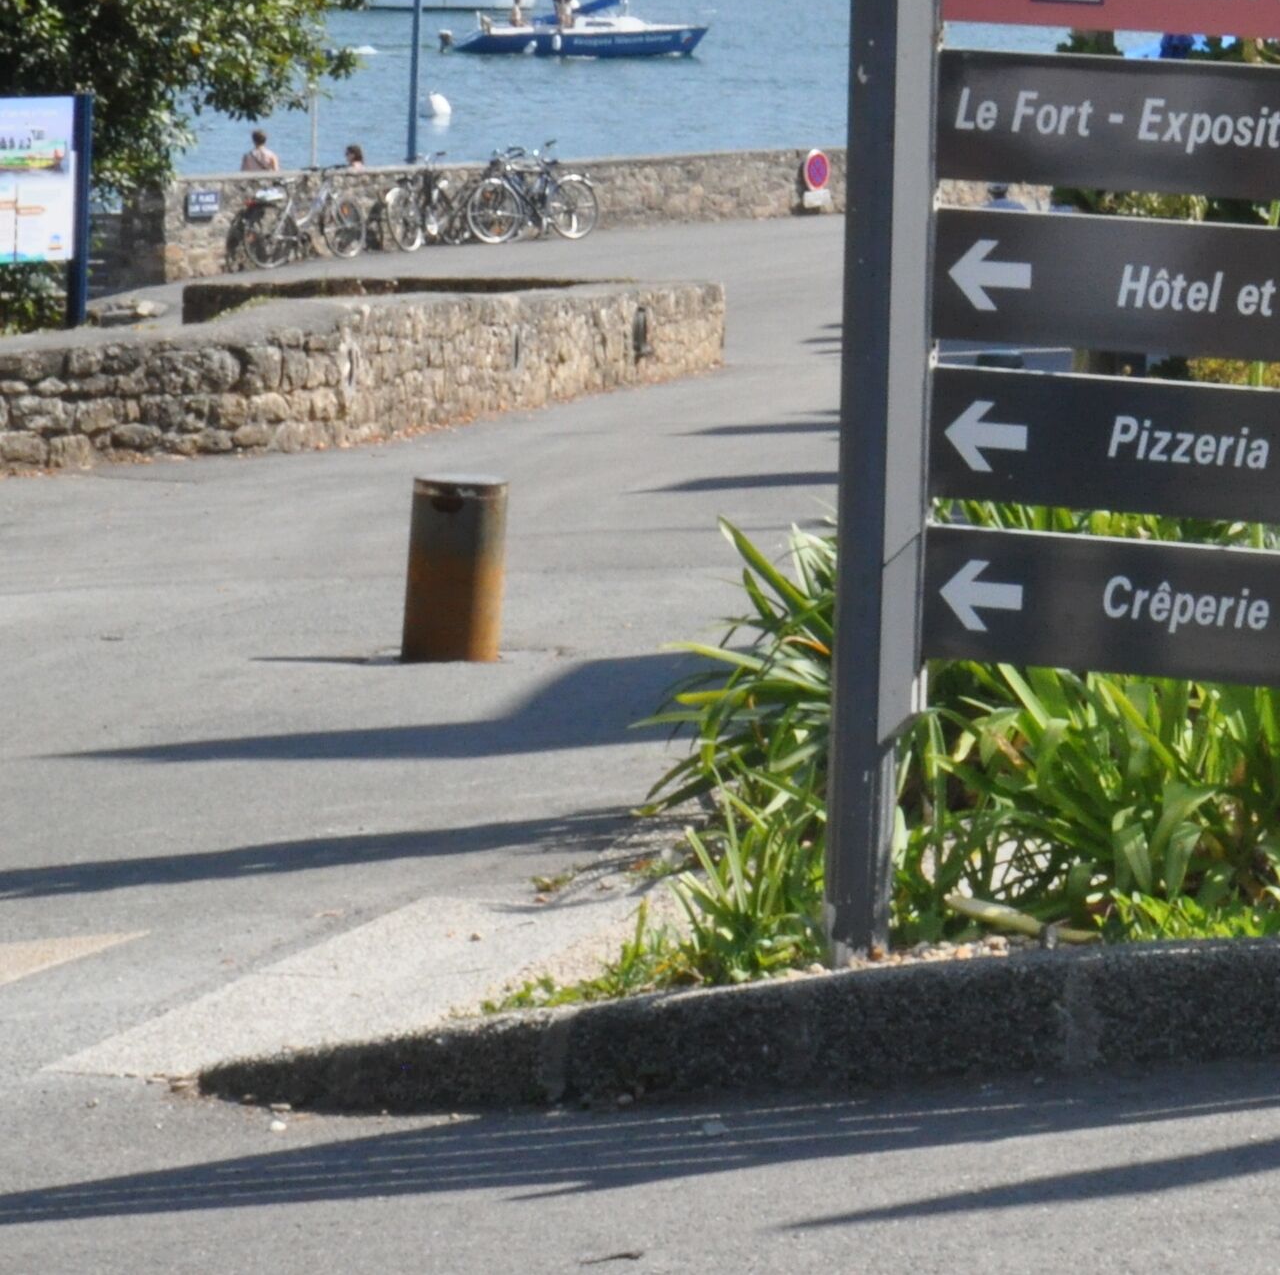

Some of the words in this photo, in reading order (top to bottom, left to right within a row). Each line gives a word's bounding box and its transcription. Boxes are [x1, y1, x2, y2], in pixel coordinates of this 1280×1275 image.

[955, 87, 998, 131] Le
[1011, 90, 1094, 137] Fort
[1116, 263, 1224, 313] Hôtel
[1236, 279, 1277, 317] et
[1107, 415, 1270, 470] Pizzeria
[1102, 575, 1270, 634] Crêperie
